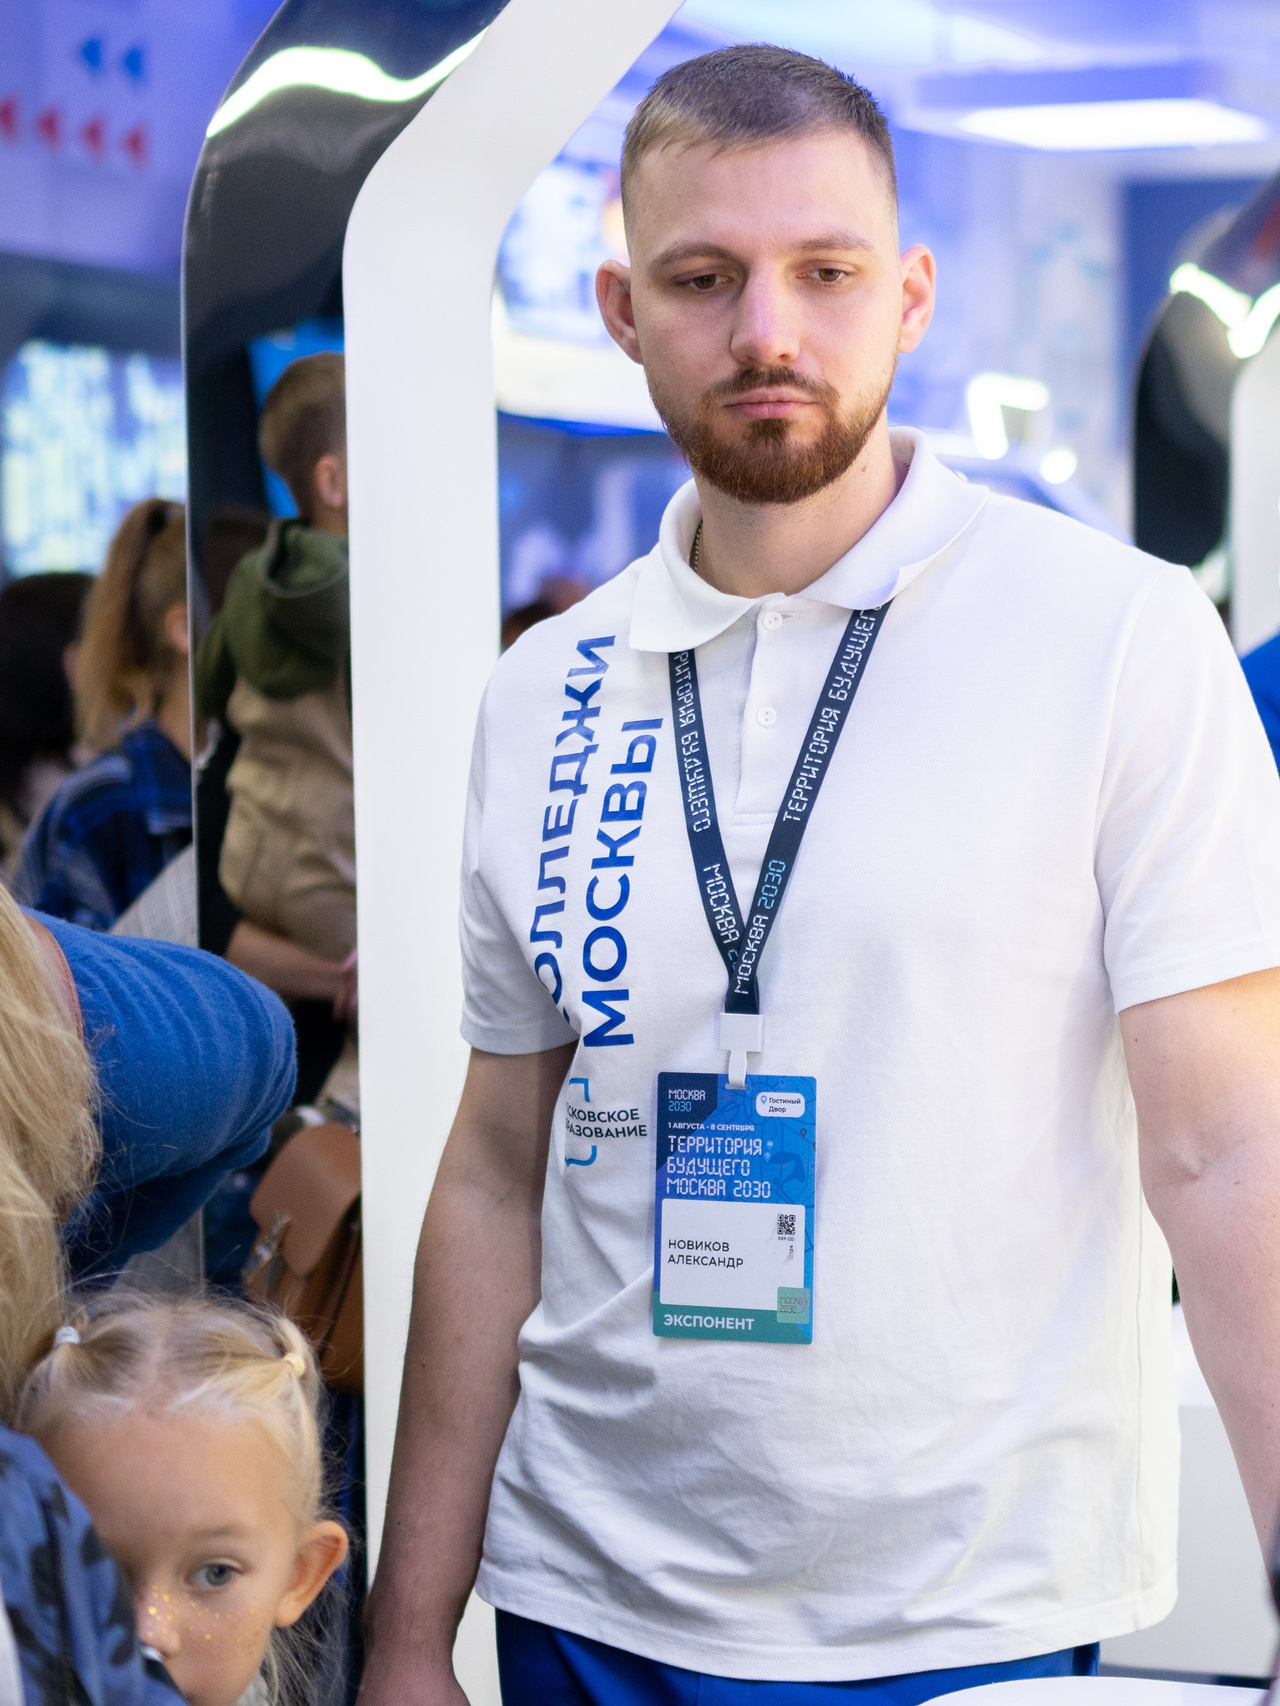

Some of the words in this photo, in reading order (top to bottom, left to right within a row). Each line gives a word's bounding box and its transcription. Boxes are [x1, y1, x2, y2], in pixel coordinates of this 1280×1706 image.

[674, 651, 696, 728] РИТОРИЯ
[783, 707, 841, 821] ТЕРРИТОРИЯ
[681, 731, 711, 832] БУДУЩЕГО
[529, 635, 616, 1024] ОЛЛЕДЖИ
[581, 718, 664, 1048] МОСКВЫ
[703, 863, 740, 944] МОСКВА
[734, 915, 769, 994] МОСКВА
[757, 860, 786, 910] 2030
[668, 1089, 706, 1101] МОСКВА
[768, 1097, 801, 1105] Гостиный
[566, 1102, 640, 1123] СКОВСКОЕ
[668, 1101, 692, 1112] 2030
[768, 1106, 787, 1114] Двор
[668, 1135, 763, 1156] ТЕРРИТОРИЯ
[666, 1156, 751, 1177] БУДУЩЕГО
[666, 1178, 726, 1196] МОСКВА
[733, 1180, 771, 1198] 2030
[668, 1239, 730, 1252] НОВИКОВ
[667, 1254, 744, 1269] АЛЕКСАНДР
[663, 1313, 755, 1331] ЭКСПОНЕНТ
